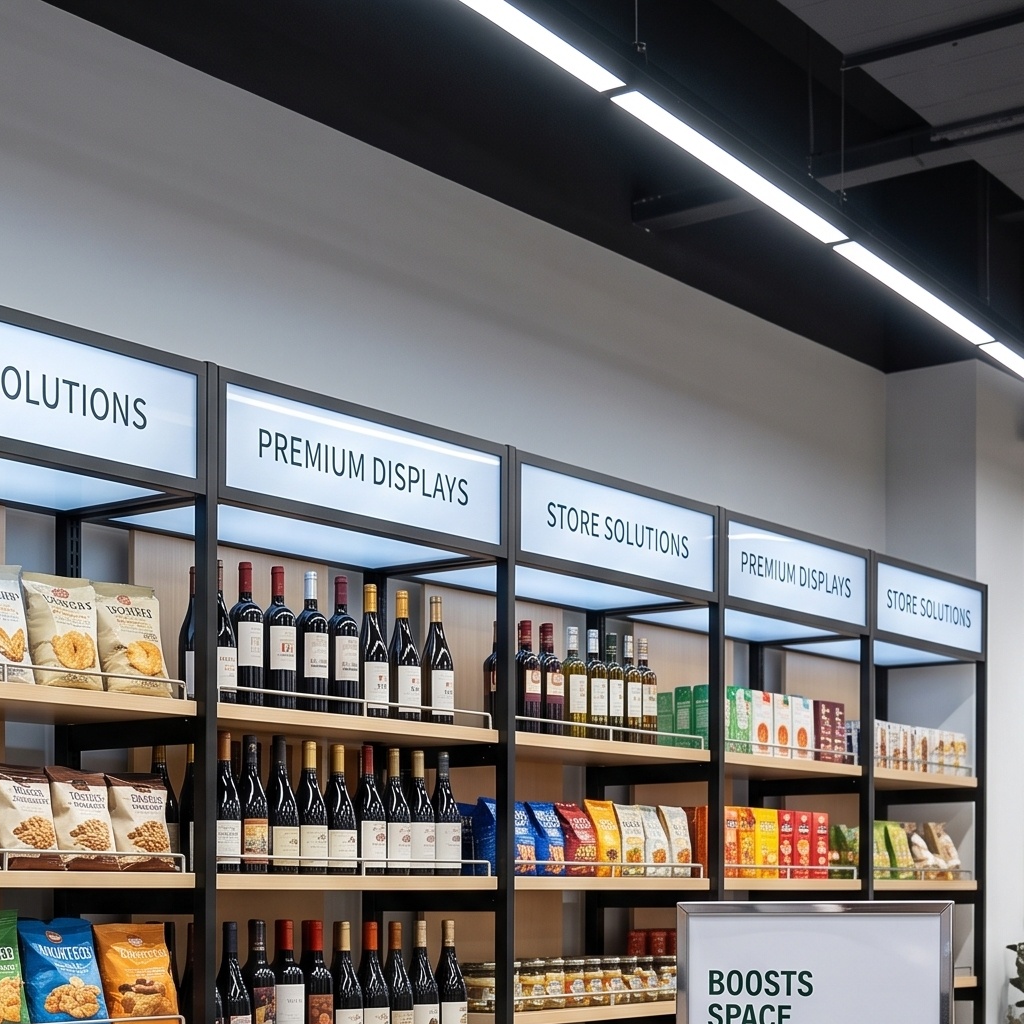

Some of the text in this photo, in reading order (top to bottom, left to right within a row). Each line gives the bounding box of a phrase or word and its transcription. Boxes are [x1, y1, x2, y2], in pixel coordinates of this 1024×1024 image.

[258, 428, 469, 506] PREMIUM DISPLAYS
[547, 502, 689, 559] STORE SOLUTIONS
[741, 551, 851, 598] PREMIUM DISPLAYS
[886, 589, 971, 628] STORE SOLUTIONS
[708, 970, 814, 997] BOOSTS
